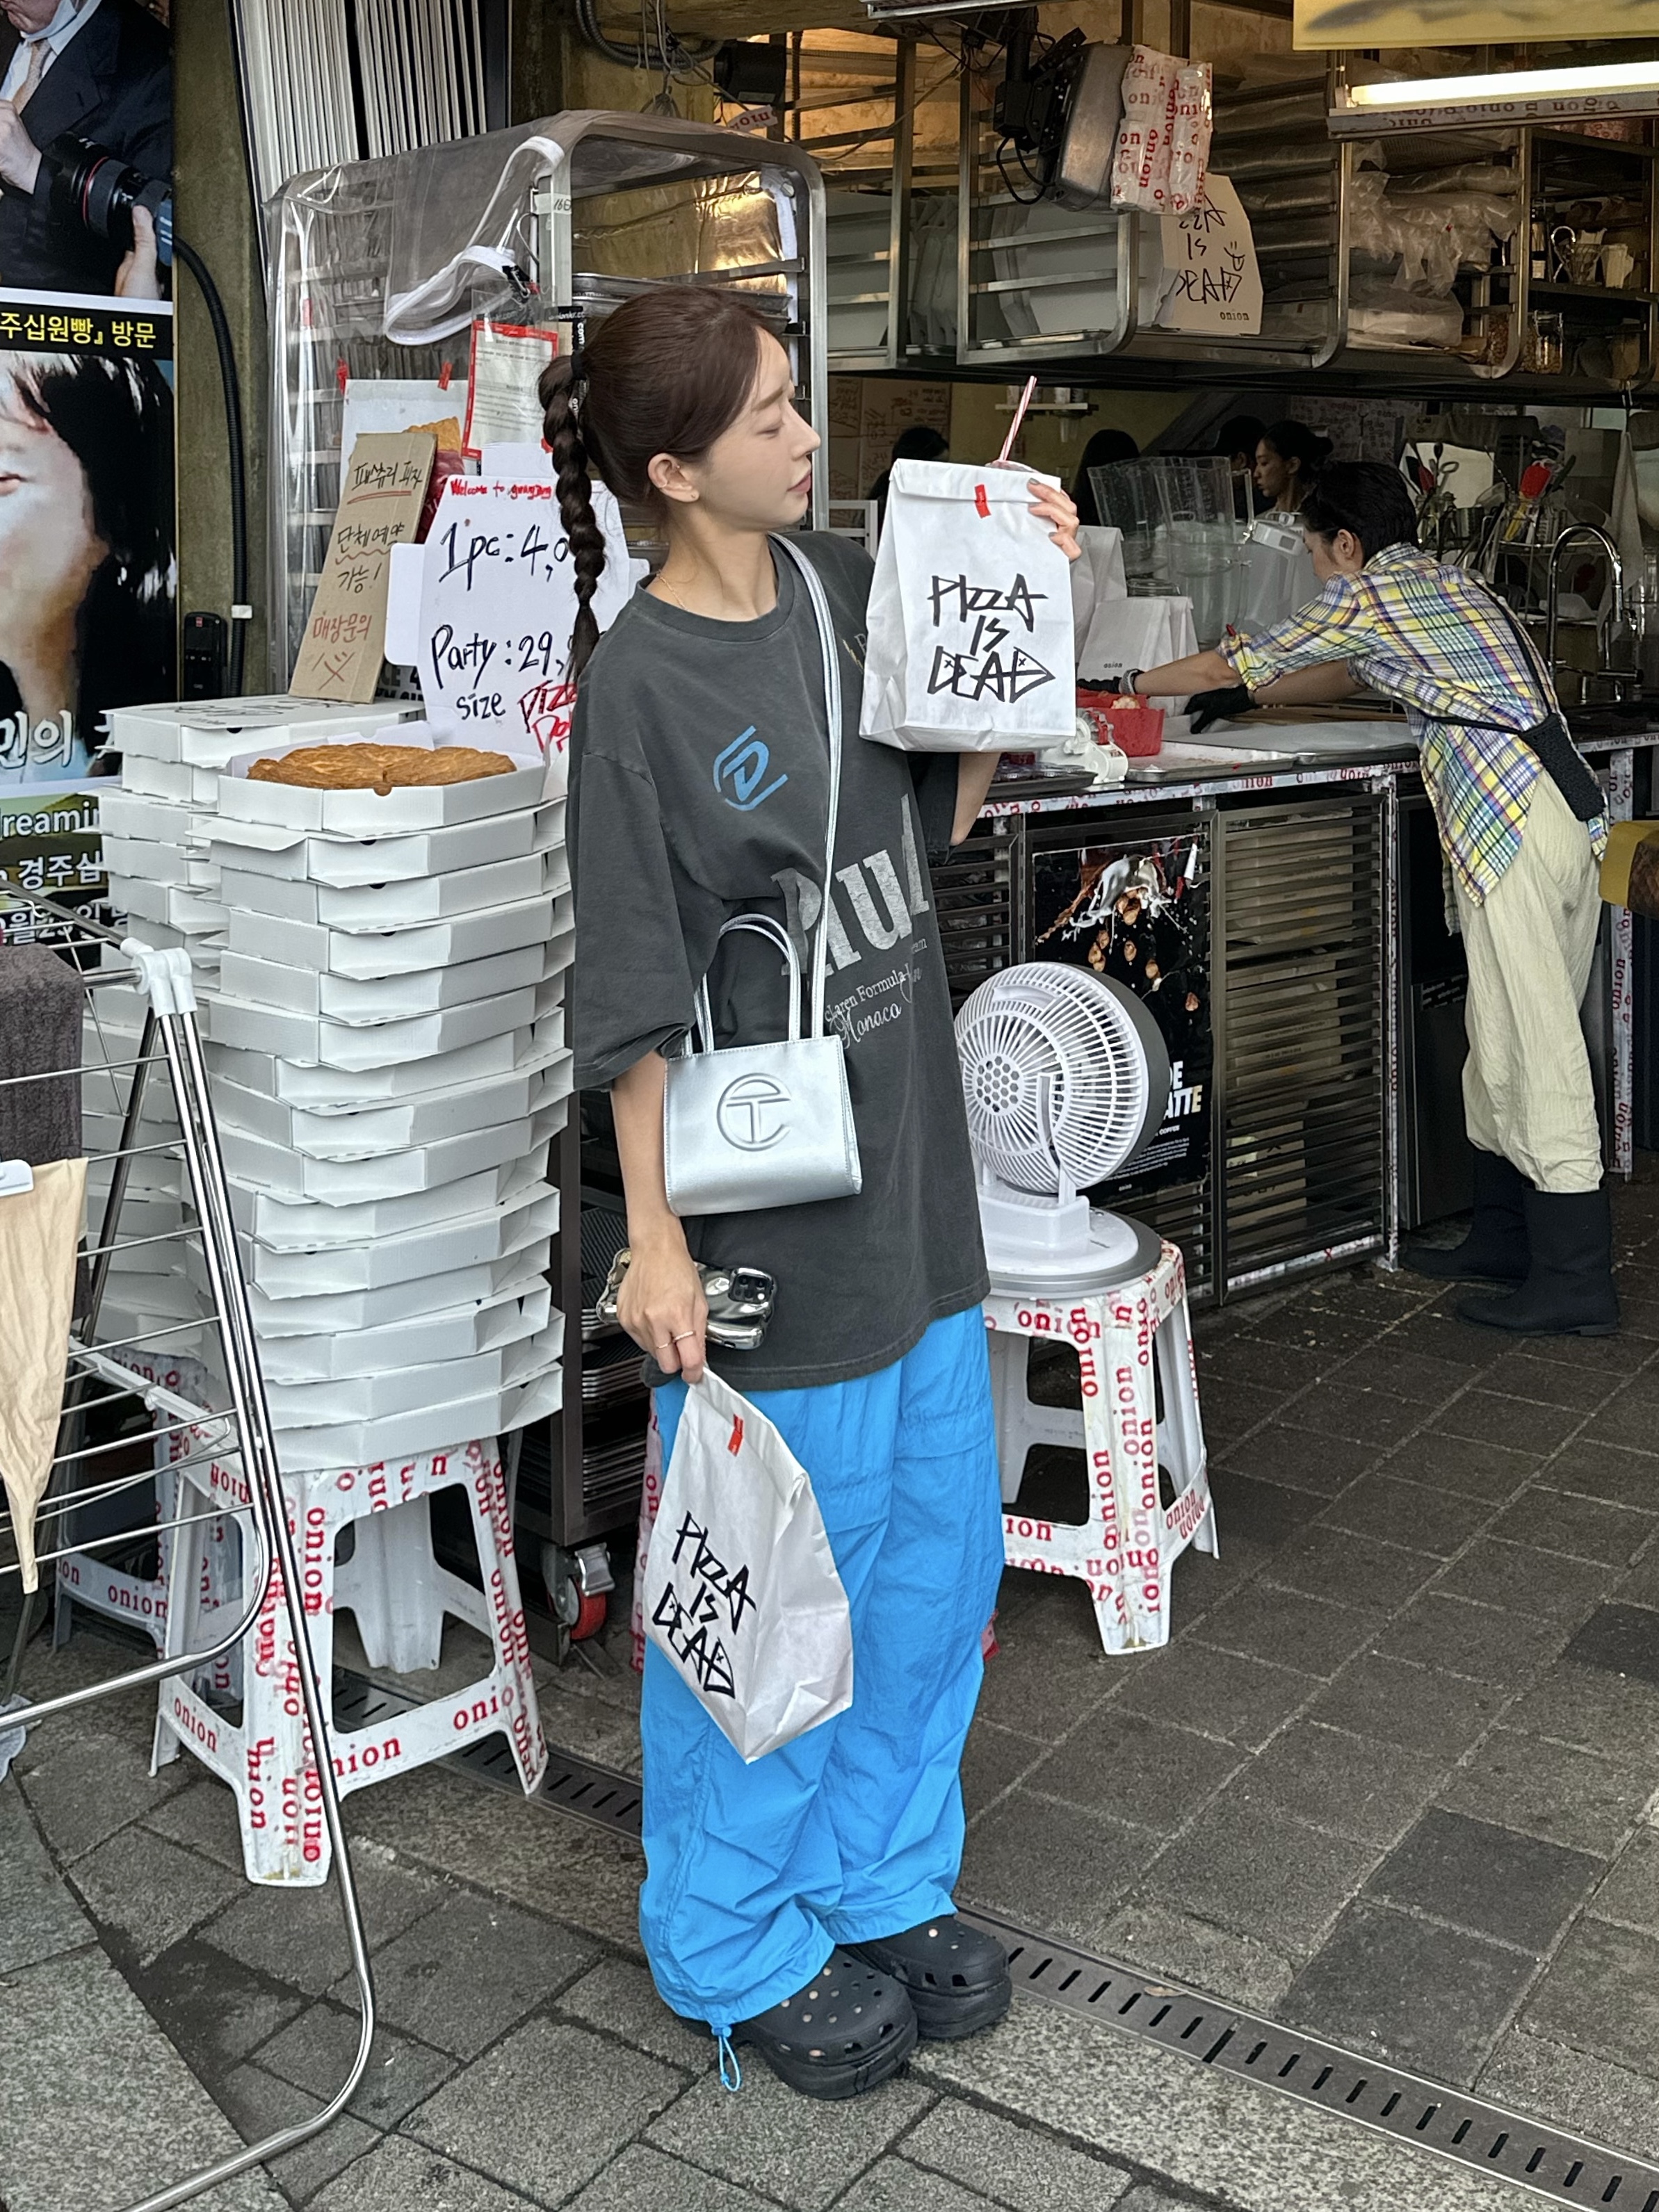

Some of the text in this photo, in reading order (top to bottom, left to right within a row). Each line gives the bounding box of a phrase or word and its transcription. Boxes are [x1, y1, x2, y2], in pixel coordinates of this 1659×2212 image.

[111, 320, 156, 348] 방문
[1220, 310, 1250, 321] onion
[451, 478, 488, 496] Welcome
[492, 480, 505, 497] to
[338, 521, 405, 554] 단체예약
[337, 562, 382, 594] 가능!
[927, 573, 1049, 633] PIZZA
[311, 612, 373, 645] 매장문의
[970, 615, 1010, 656] IS
[927, 645, 1056, 704] DEAD
[456, 693, 506, 721] size
[1116, 1367, 1140, 1456] onion
[1140, 1418, 1156, 1510] onion
[1166, 1488, 1196, 1530] onion
[304, 1506, 325, 1612] onion
[672, 1510, 757, 1636] PIZZA
[108, 1584, 168, 1619] onion
[491, 1568, 515, 1666] onion
[688, 1581, 720, 1625] IS
[652, 1581, 736, 1700] DEAD
[175, 1697, 217, 1753] onion
